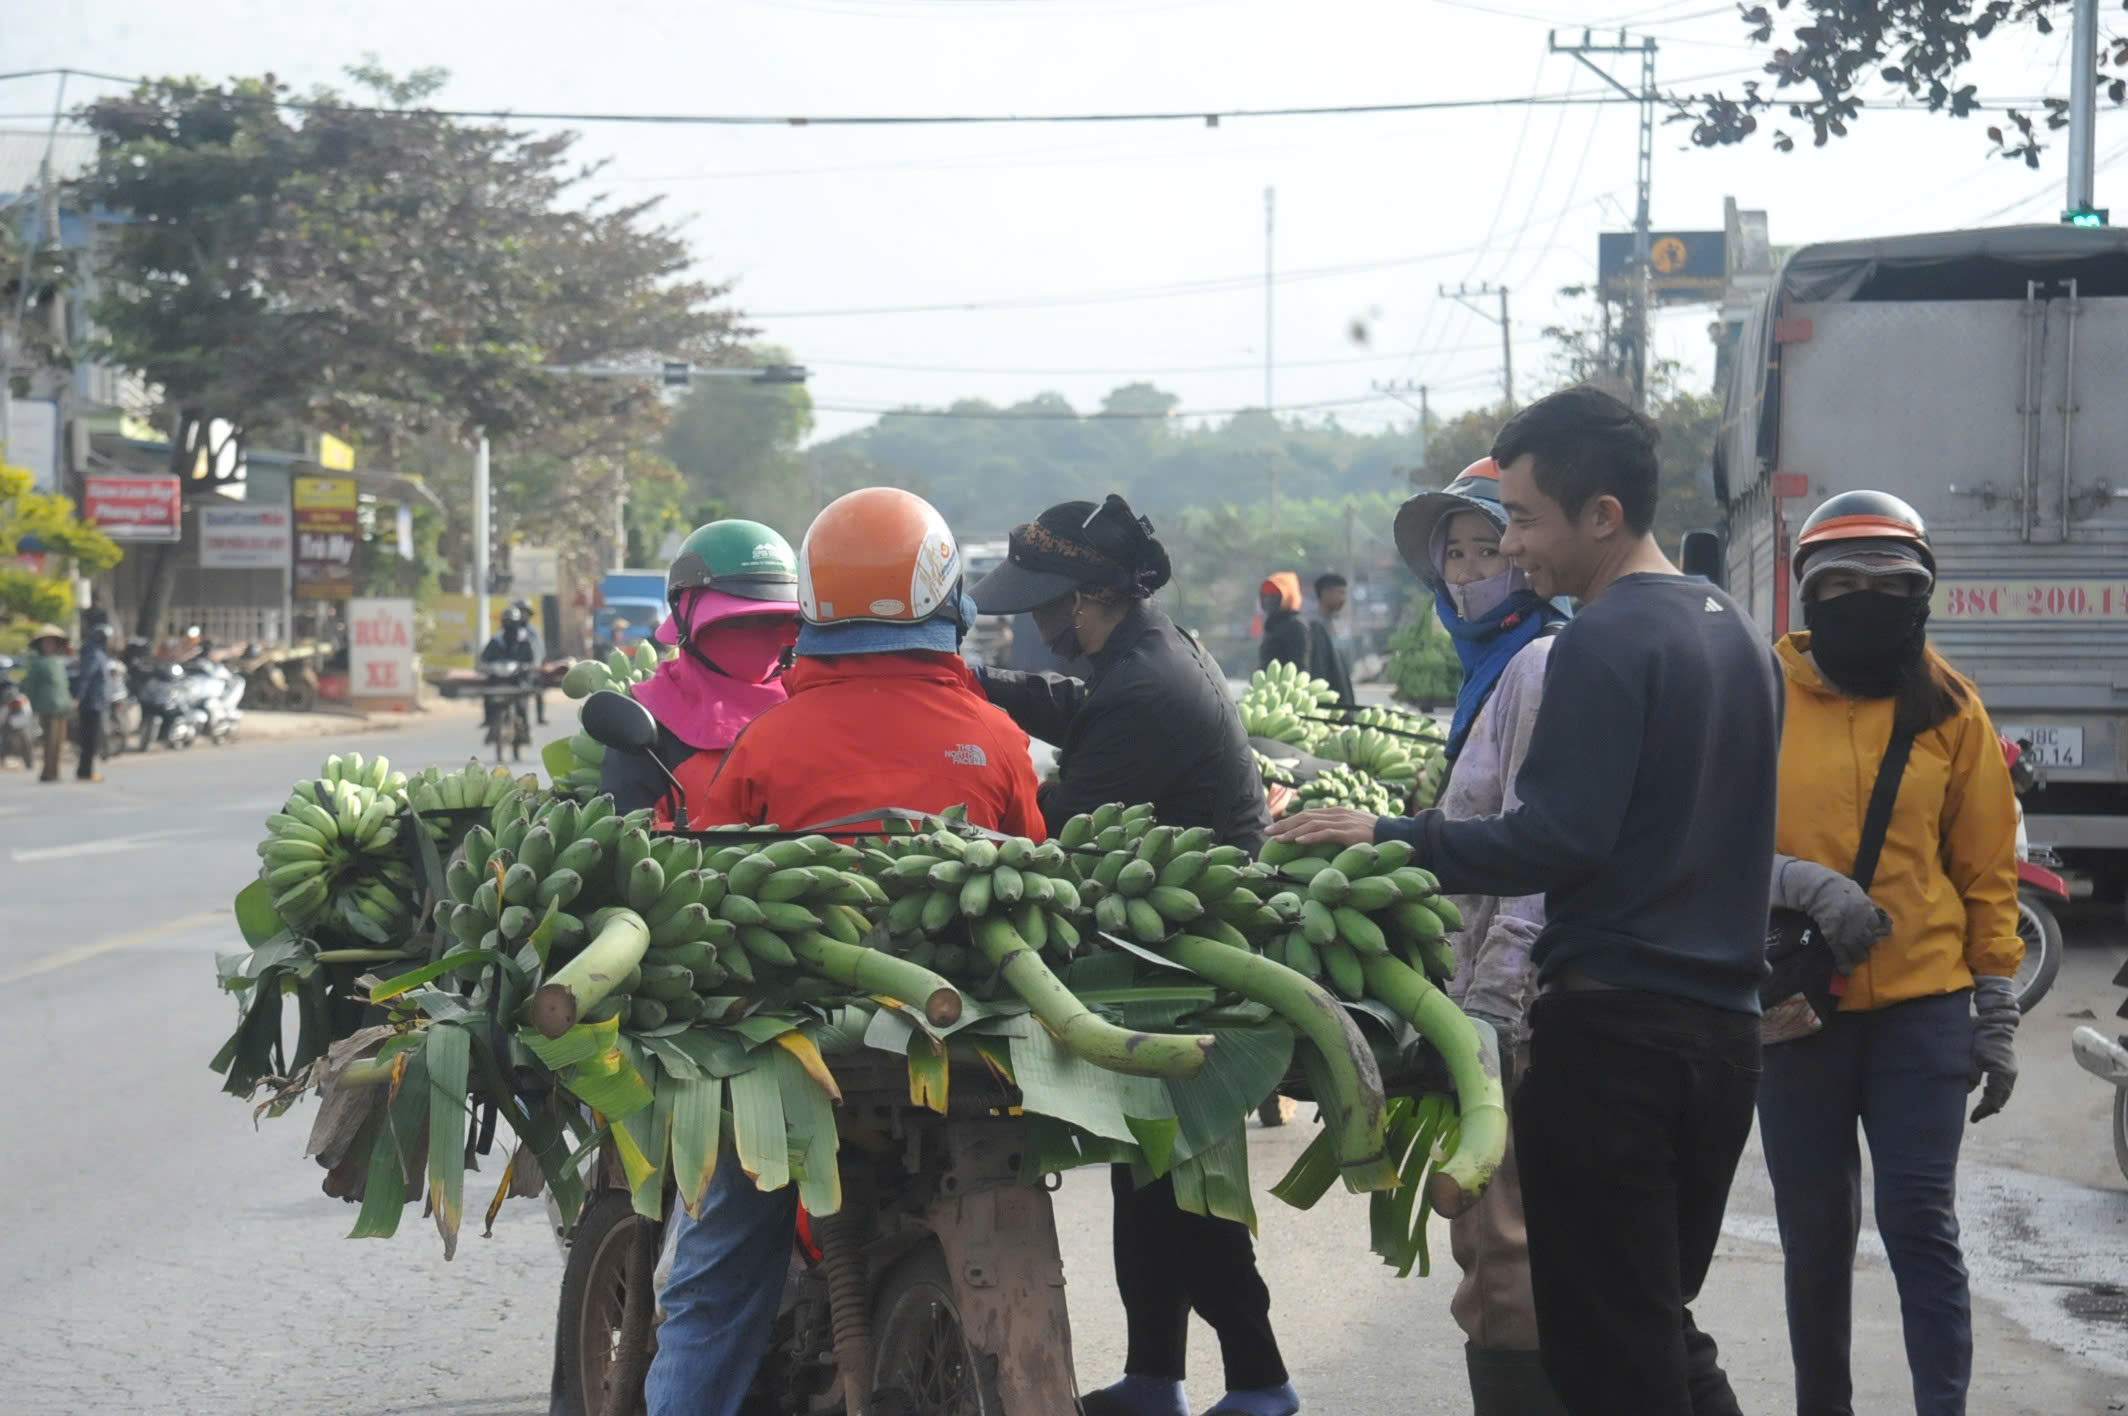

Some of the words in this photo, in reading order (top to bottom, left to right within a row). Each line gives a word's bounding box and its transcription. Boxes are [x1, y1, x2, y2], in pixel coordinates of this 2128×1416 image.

[365, 660, 400, 688] XE
[956, 743, 972, 751] THE
[944, 749, 972, 760] NORTH
